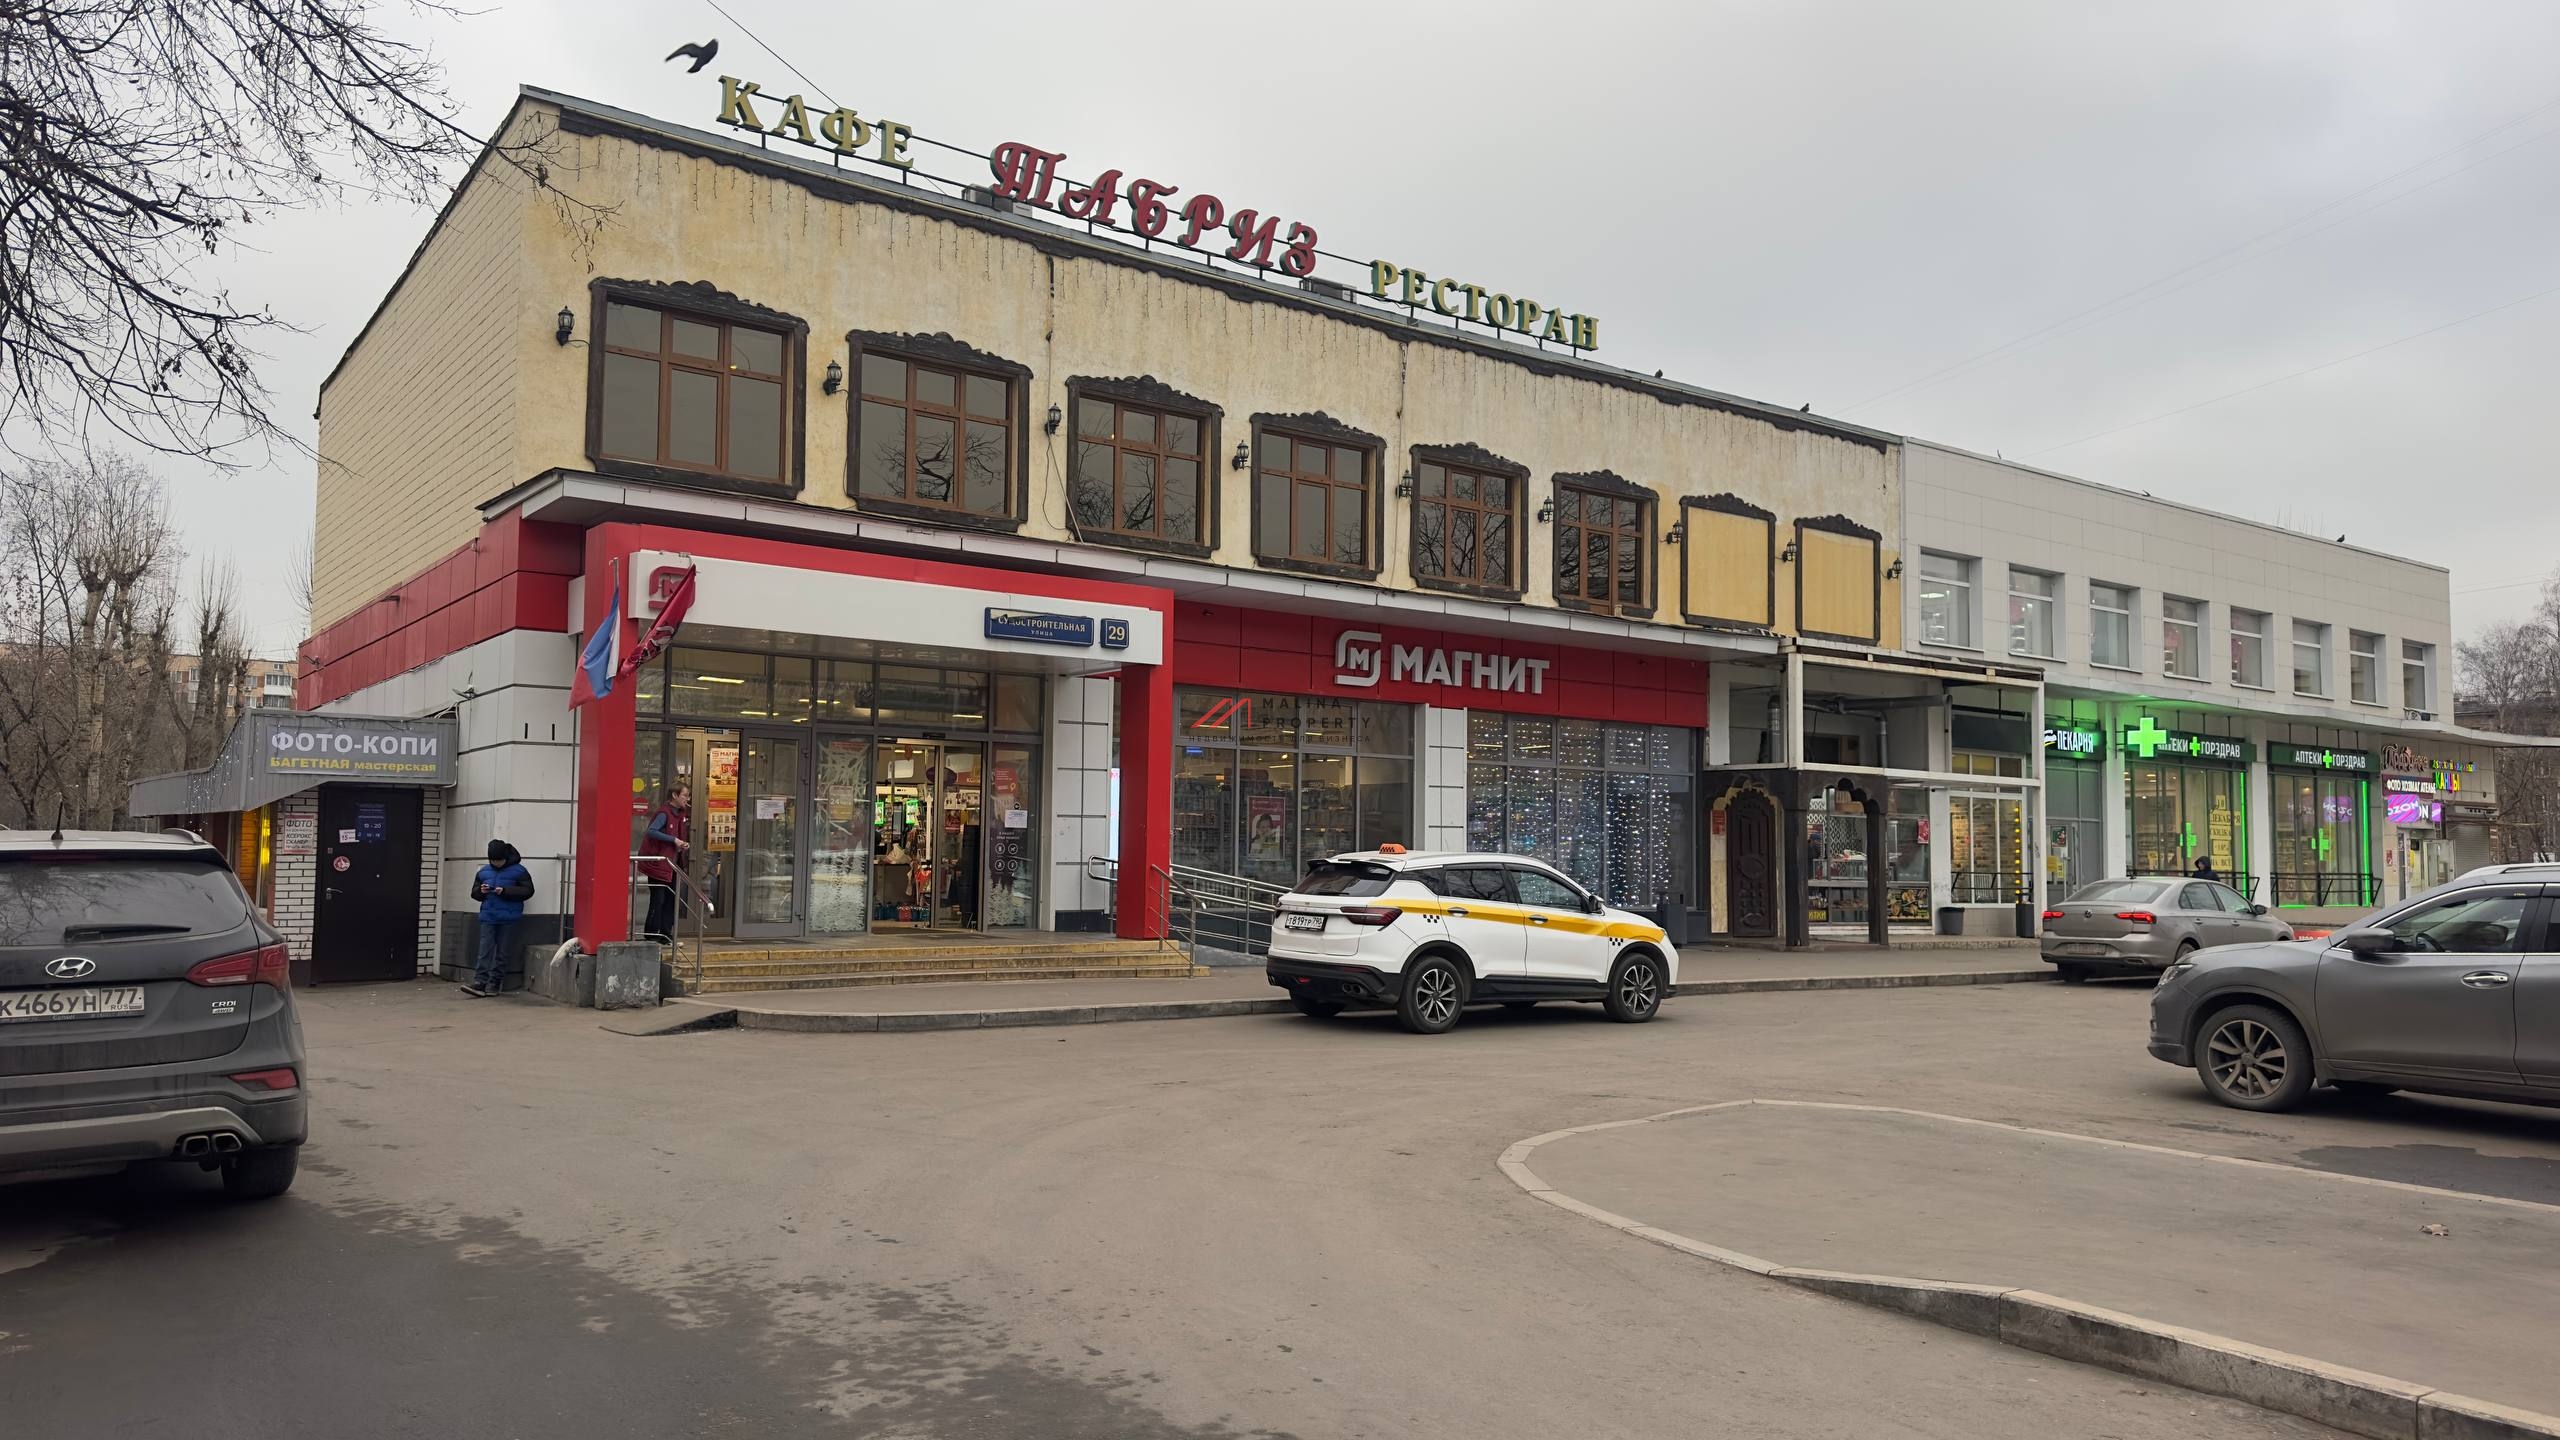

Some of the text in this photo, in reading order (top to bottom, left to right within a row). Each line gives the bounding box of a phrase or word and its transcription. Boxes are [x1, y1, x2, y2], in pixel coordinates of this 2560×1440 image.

[716, 75, 914, 170] КАФЕ
[989, 141, 1318, 277] ТАБРИЗ
[1370, 259, 1600, 351] РЕСТОРАН
[1031, 629, 1053, 637] УЛИЦА
[1108, 625, 1126, 640] 29
[1390, 644, 1550, 694] МАГНИТ
[271, 732, 437, 756] ФОТО-КОПИ
[2057, 730, 2094, 753] ПЕКАРНЯ
[2201, 741, 2240, 758] ГОРЗДРАВ
[270, 757, 437, 773] БАГЕТНАЯ мастерская
[2295, 750, 2322, 765] АПТЕКИ
[2332, 754, 2366, 769] ГОРЗДРАВ
[286, 820, 313, 828] ФОТО
[0, 988, 138, 1016] К466УН 777
[211, 1000, 237, 1008] CRDI
